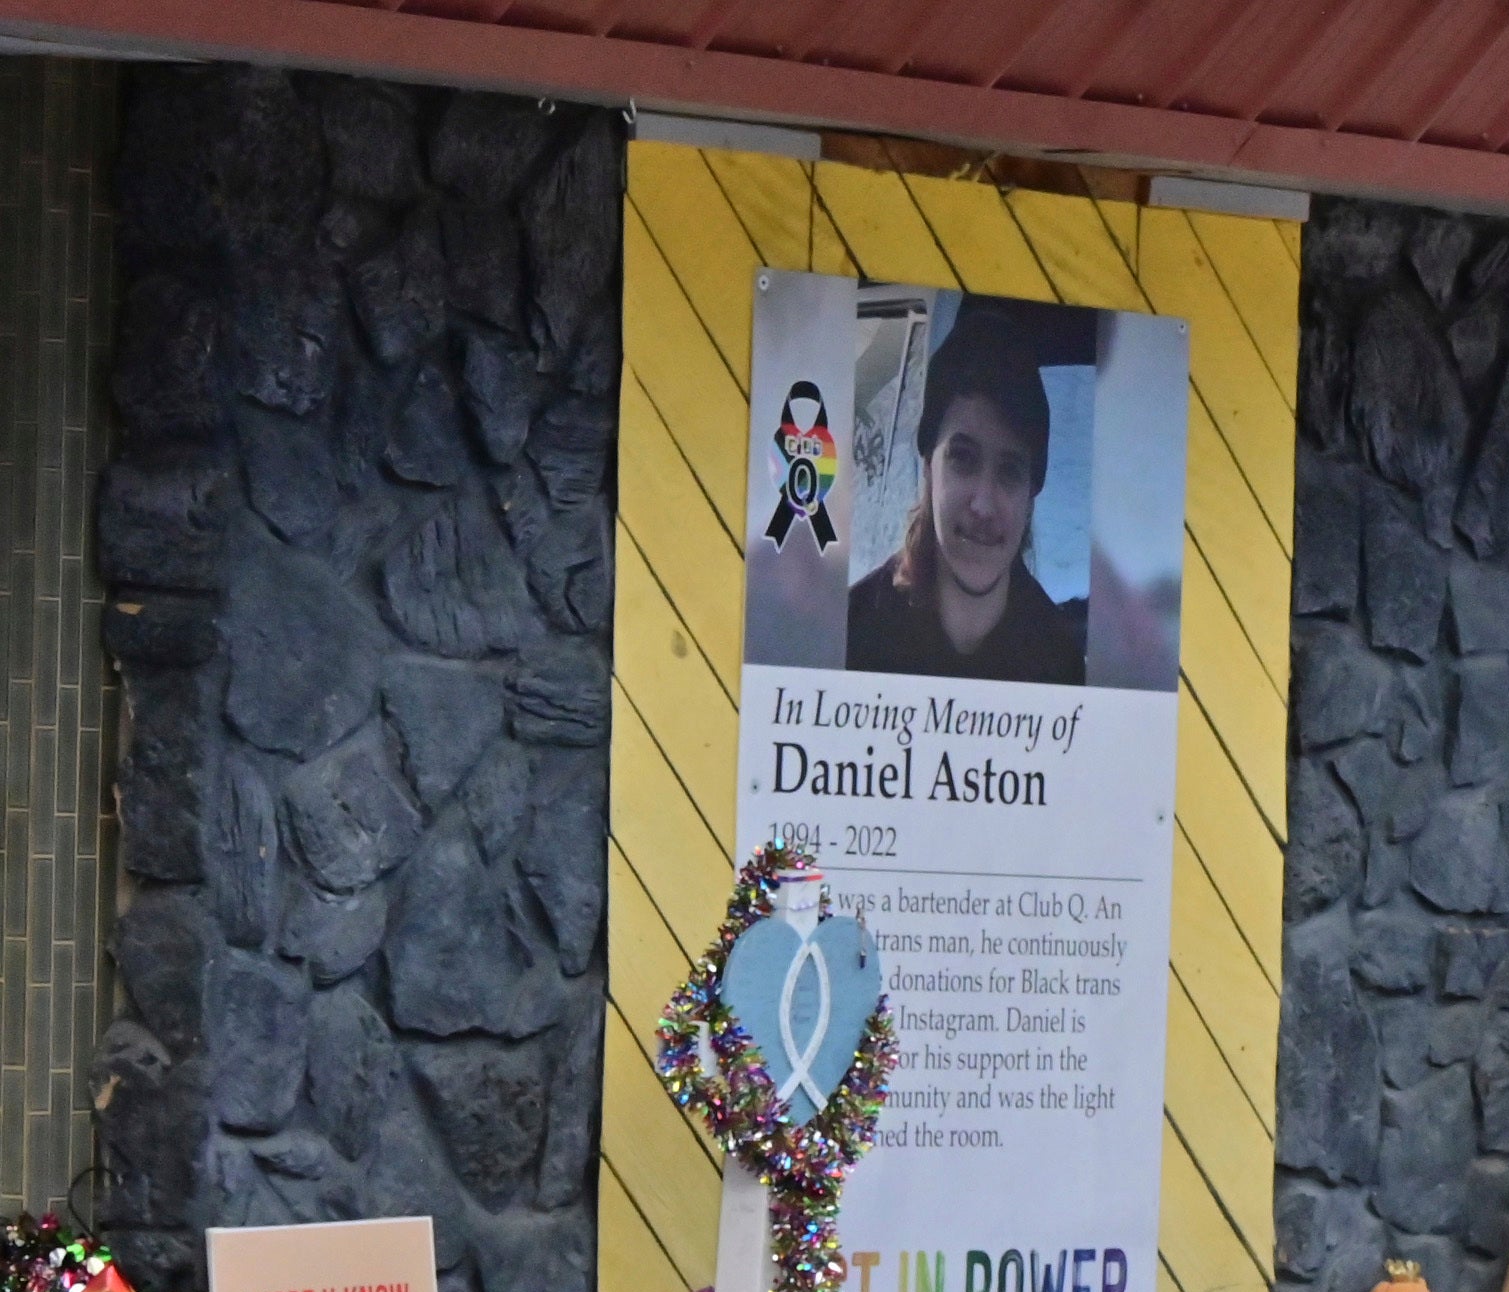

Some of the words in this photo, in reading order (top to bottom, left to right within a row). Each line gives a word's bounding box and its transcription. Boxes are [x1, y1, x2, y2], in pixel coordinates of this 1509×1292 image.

[772, 687, 802, 725] In
[813, 690, 917, 745] Loving
[924, 697, 1043, 752] Memory
[1052, 704, 1083, 753] of
[772, 741, 913, 799] Daniel
[928, 751, 1048, 806] Aston
[769, 822, 822, 853] 1994
[846, 826, 897, 857] 2022
[838, 891, 875, 912] was
[882, 894, 891, 912] a
[898, 888, 991, 915] bartender
[995, 898, 1013, 916] at
[1018, 891, 1063, 918] Club
[1068, 893, 1089, 924] Q.
[1095, 895, 1122, 920] An
[875, 930, 922, 952] trans
[929, 934, 974, 958] man,
[981, 930, 1002, 955] he
[1008, 933, 1127, 967] continuously
[889, 965, 983, 993] donations
[989, 967, 1015, 993] for
[1022, 968, 1068, 995] Black
[1076, 973, 1121, 996] trans
[900, 1006, 1000, 1040] Instagram.
[1006, 1006, 1065, 1033] Daniel
[1071, 1012, 1086, 1034] is
[900, 1050, 919, 1070] or
[924, 1044, 951, 1071] his
[957, 1050, 1031, 1079] support
[1035, 1048, 1054, 1072] in
[1059, 1046, 1088, 1072] the
[957, 1084, 992, 1109] and
[998, 1091, 1033, 1109] was
[1040, 1084, 1068, 1110] the
[1074, 1085, 1115, 1118] light
[915, 1122, 943, 1147] the
[950, 1127, 1003, 1147] room.
